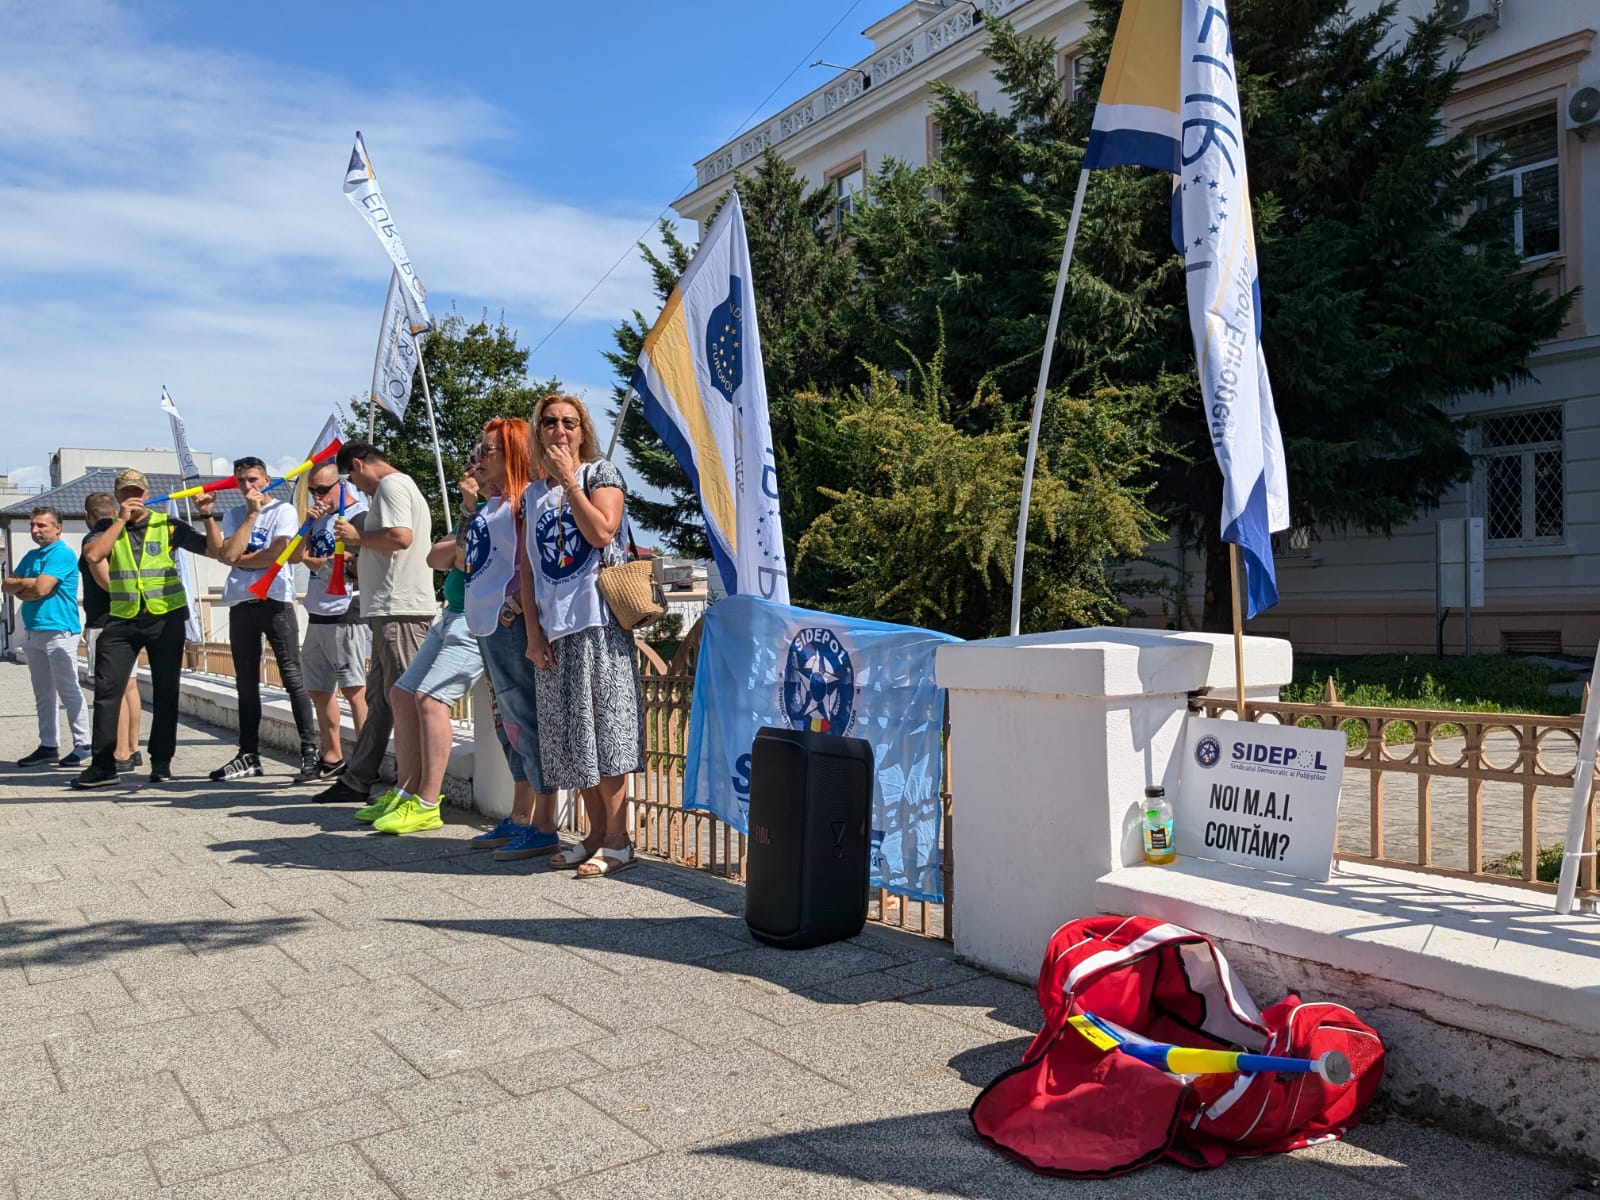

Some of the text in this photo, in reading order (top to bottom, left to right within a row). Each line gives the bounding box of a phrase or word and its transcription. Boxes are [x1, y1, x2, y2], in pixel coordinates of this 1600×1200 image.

[794, 629, 846, 665] SIDEPOL
[1230, 763, 1257, 773] Sindicatul
[1257, 766, 1288, 777] Democratic
[1209, 783, 1293, 822] NOI M.A.I.
[1204, 821, 1291, 862] CONTĂM?
